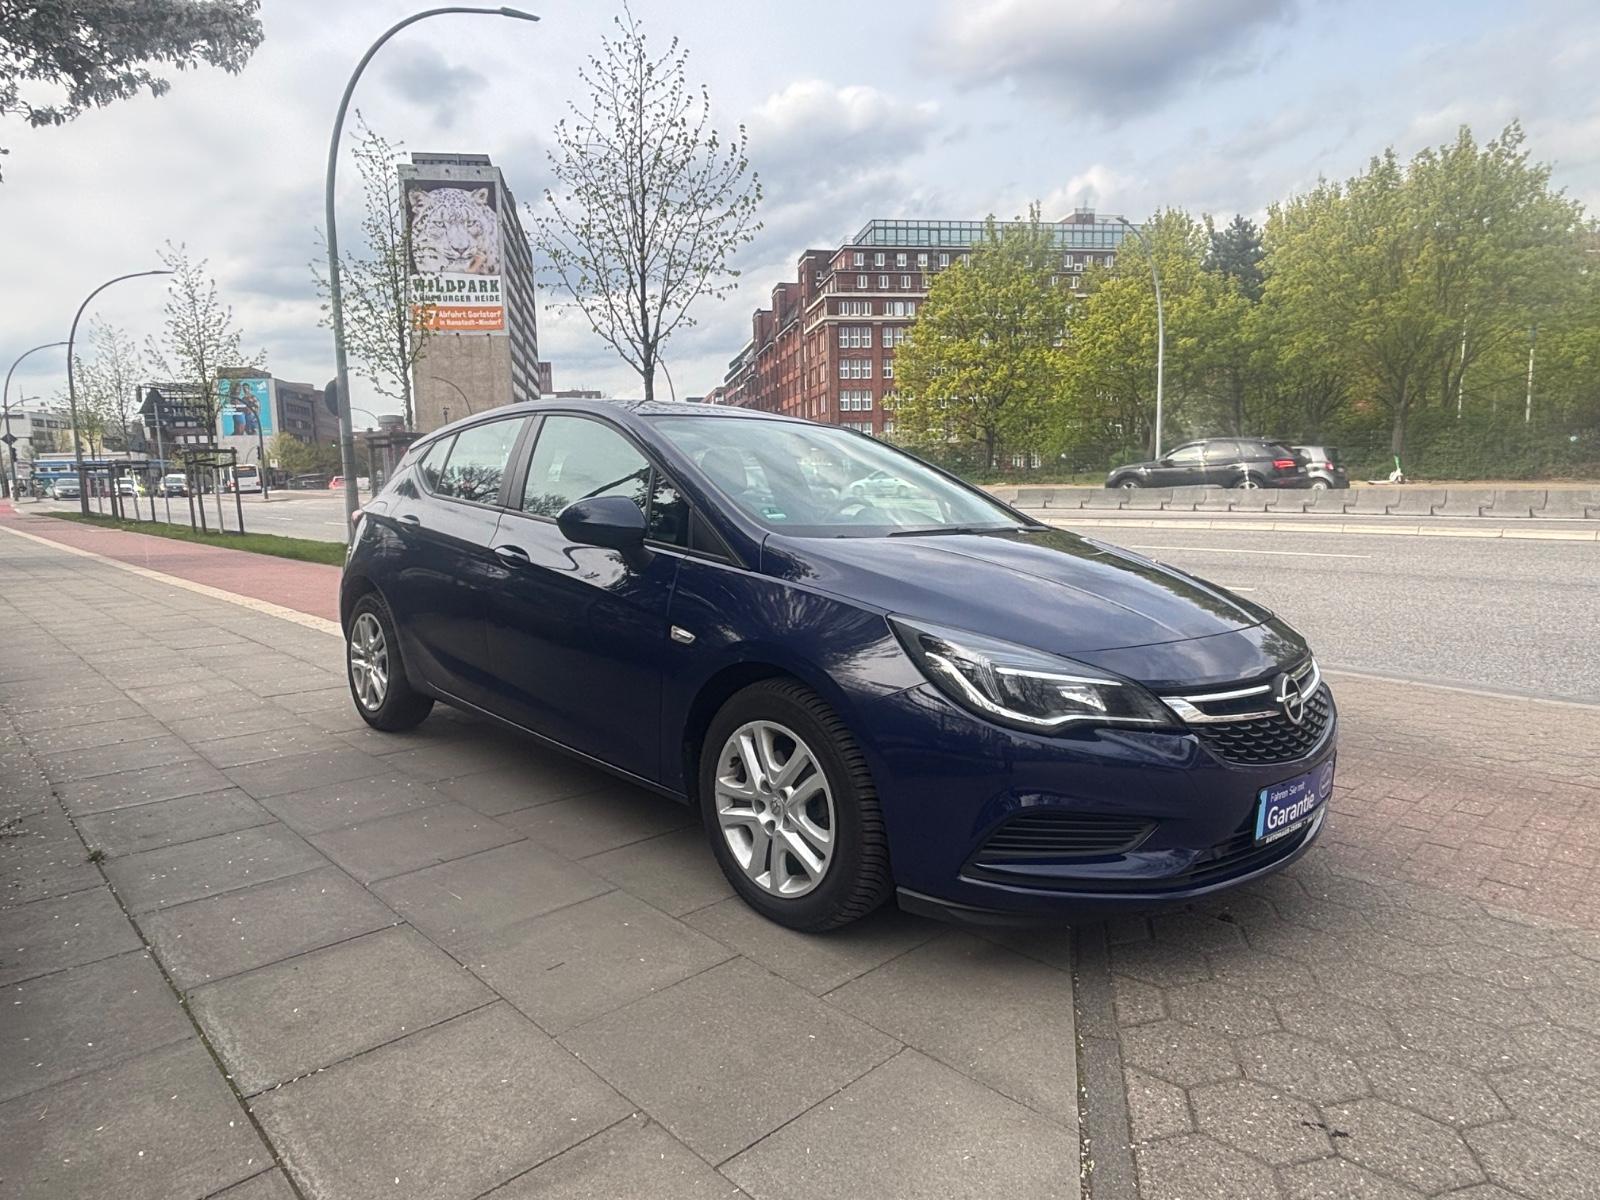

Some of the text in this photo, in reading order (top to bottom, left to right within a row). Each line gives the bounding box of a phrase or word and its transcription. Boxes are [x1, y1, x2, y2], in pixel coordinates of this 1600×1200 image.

[413, 280, 499, 292] WILDPARK
[1271, 791, 1288, 802] Fahren
[1289, 786, 1297, 795] Sie
[1268, 789, 1315, 829] Garantie
